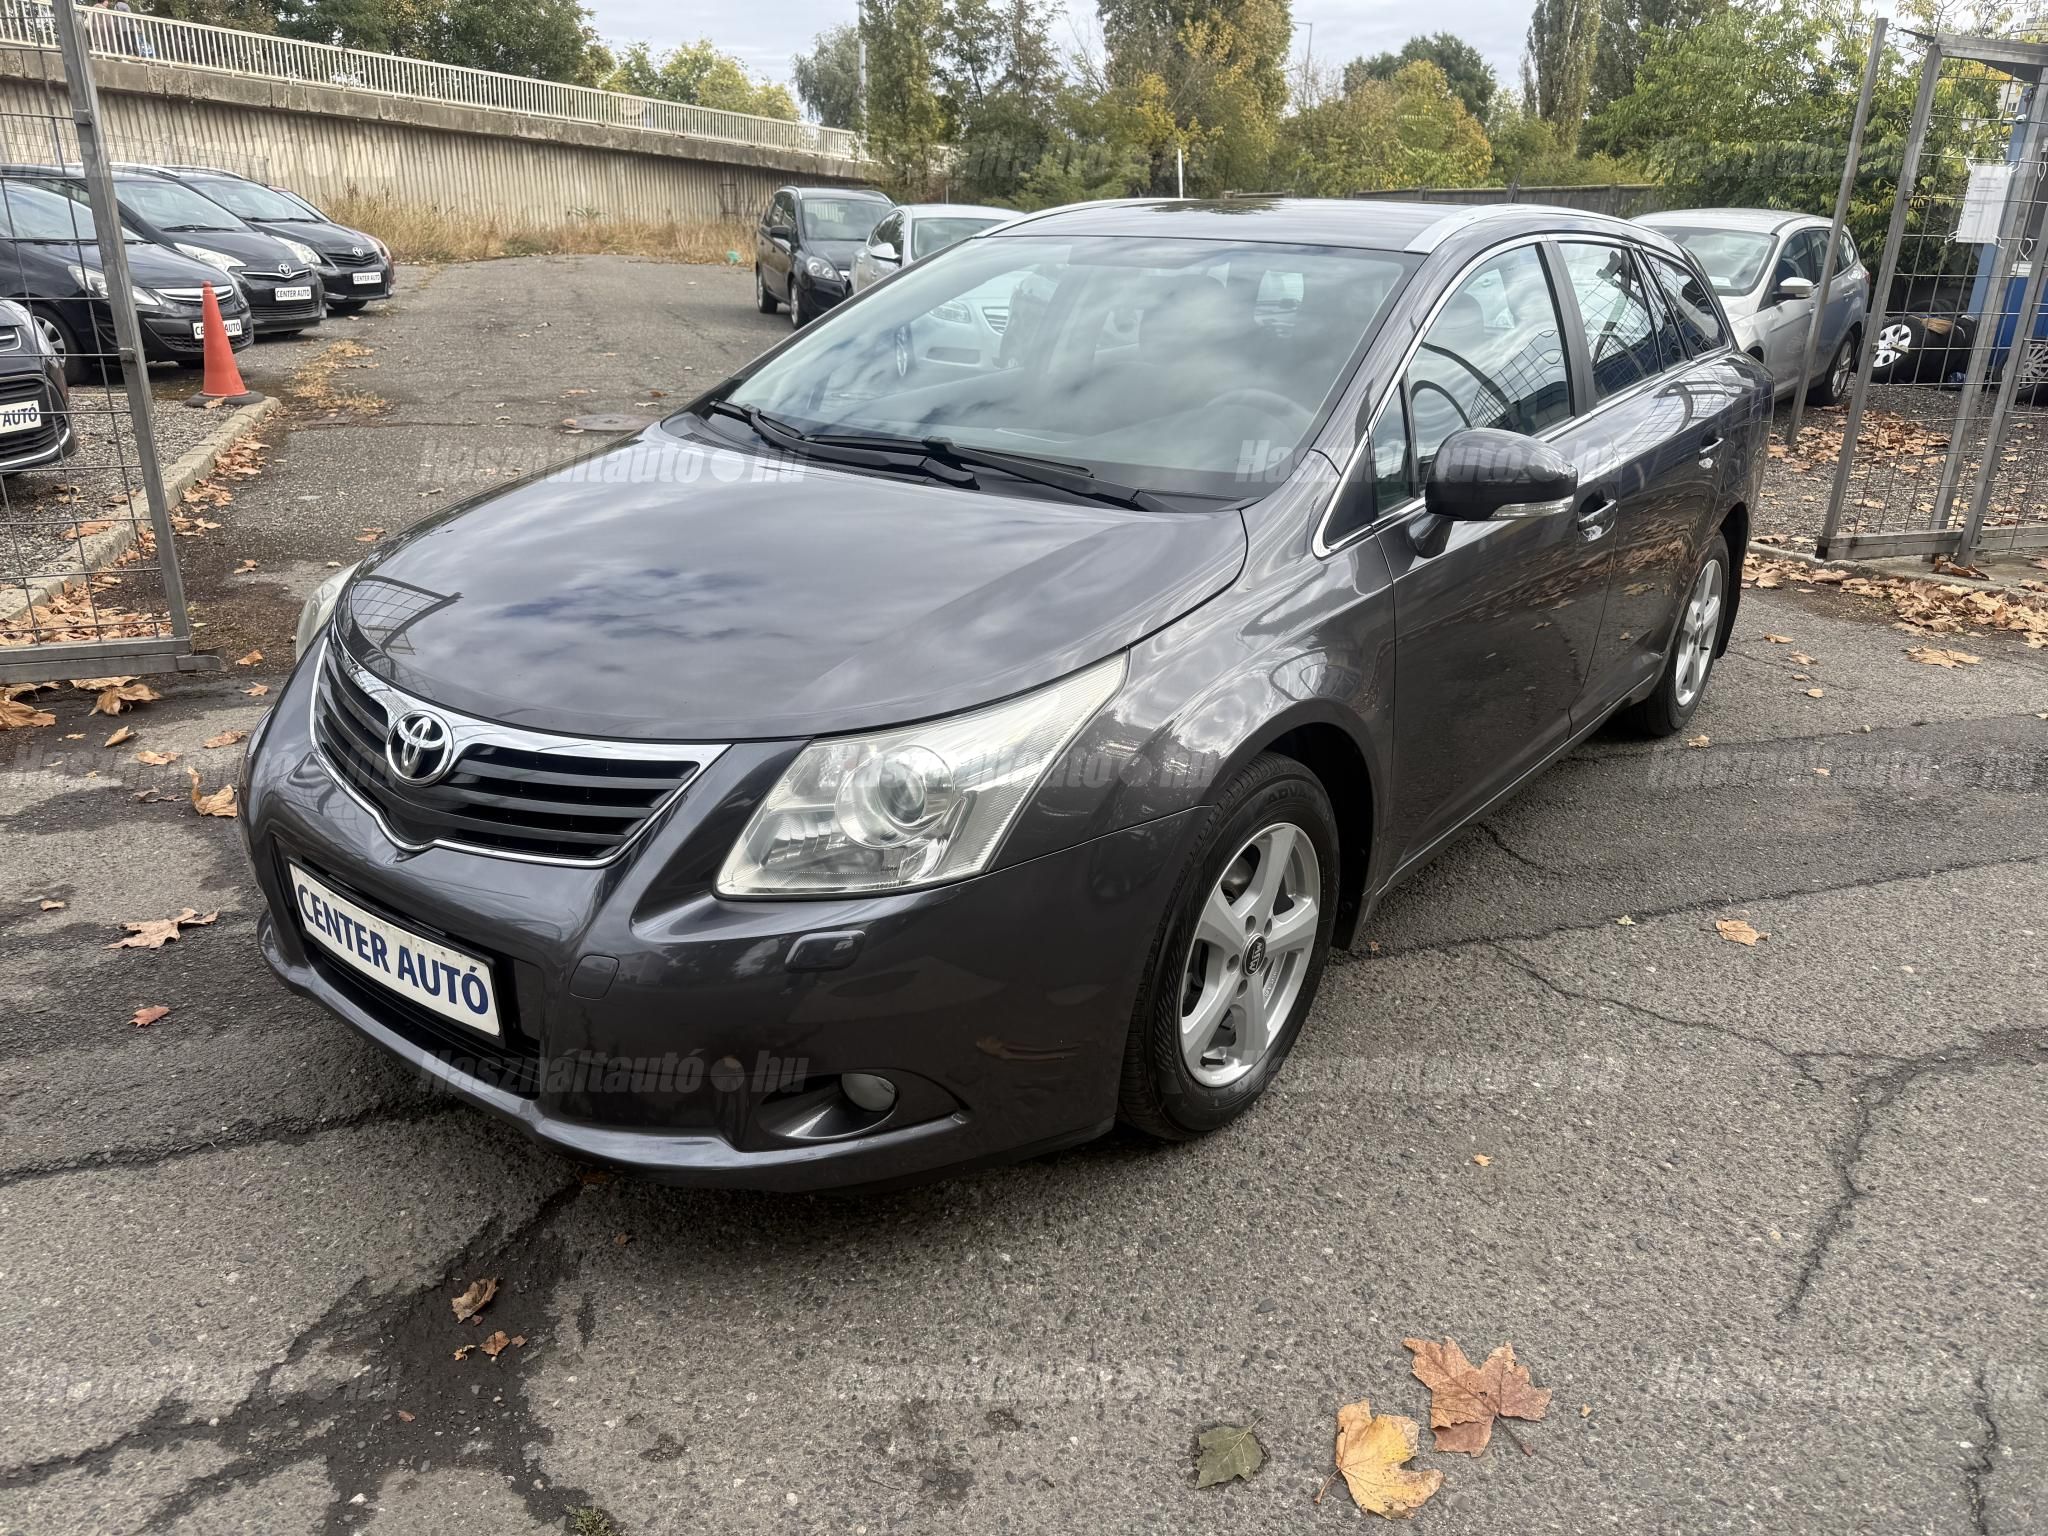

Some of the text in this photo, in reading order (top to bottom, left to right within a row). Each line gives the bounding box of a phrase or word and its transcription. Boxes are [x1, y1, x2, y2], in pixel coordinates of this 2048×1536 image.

[276, 290, 296, 298] CENTER
[3, 403, 37, 427] AUTÓ
[298, 884, 489, 1015] CENTER AUTÓ
